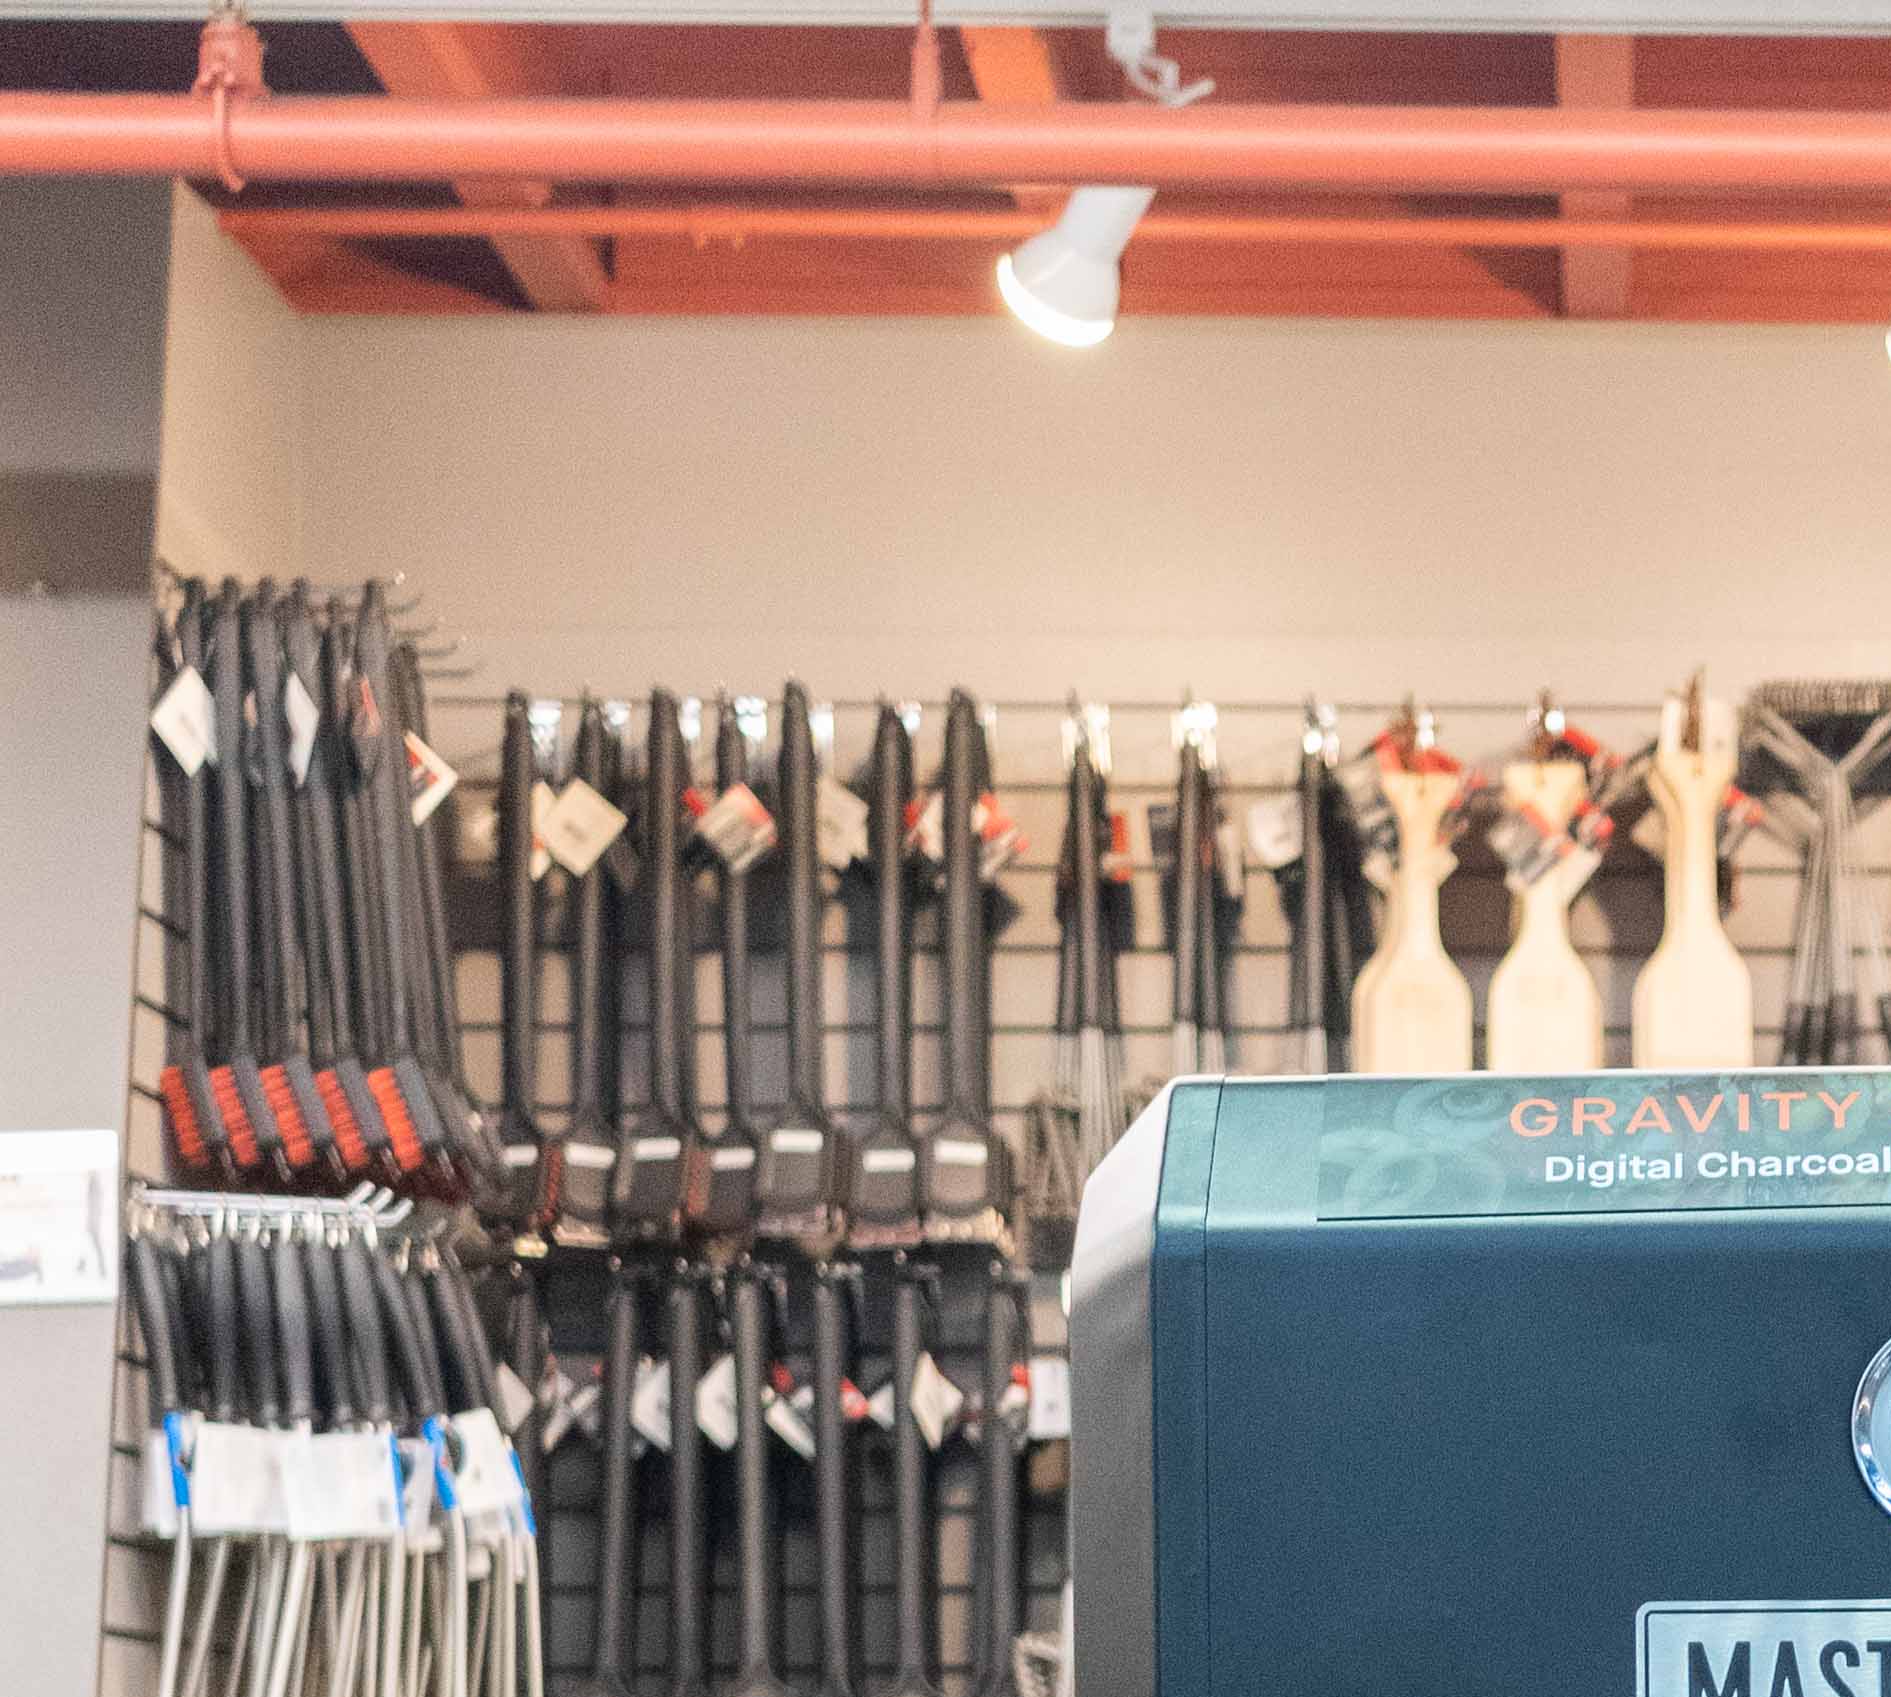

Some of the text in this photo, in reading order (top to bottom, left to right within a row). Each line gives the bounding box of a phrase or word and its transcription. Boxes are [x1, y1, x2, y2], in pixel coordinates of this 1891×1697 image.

[1509, 1091, 1862, 1138] GRAVITY
[1545, 1151, 1683, 1188] Digital
[1697, 1145, 1891, 1178] Charcoal
